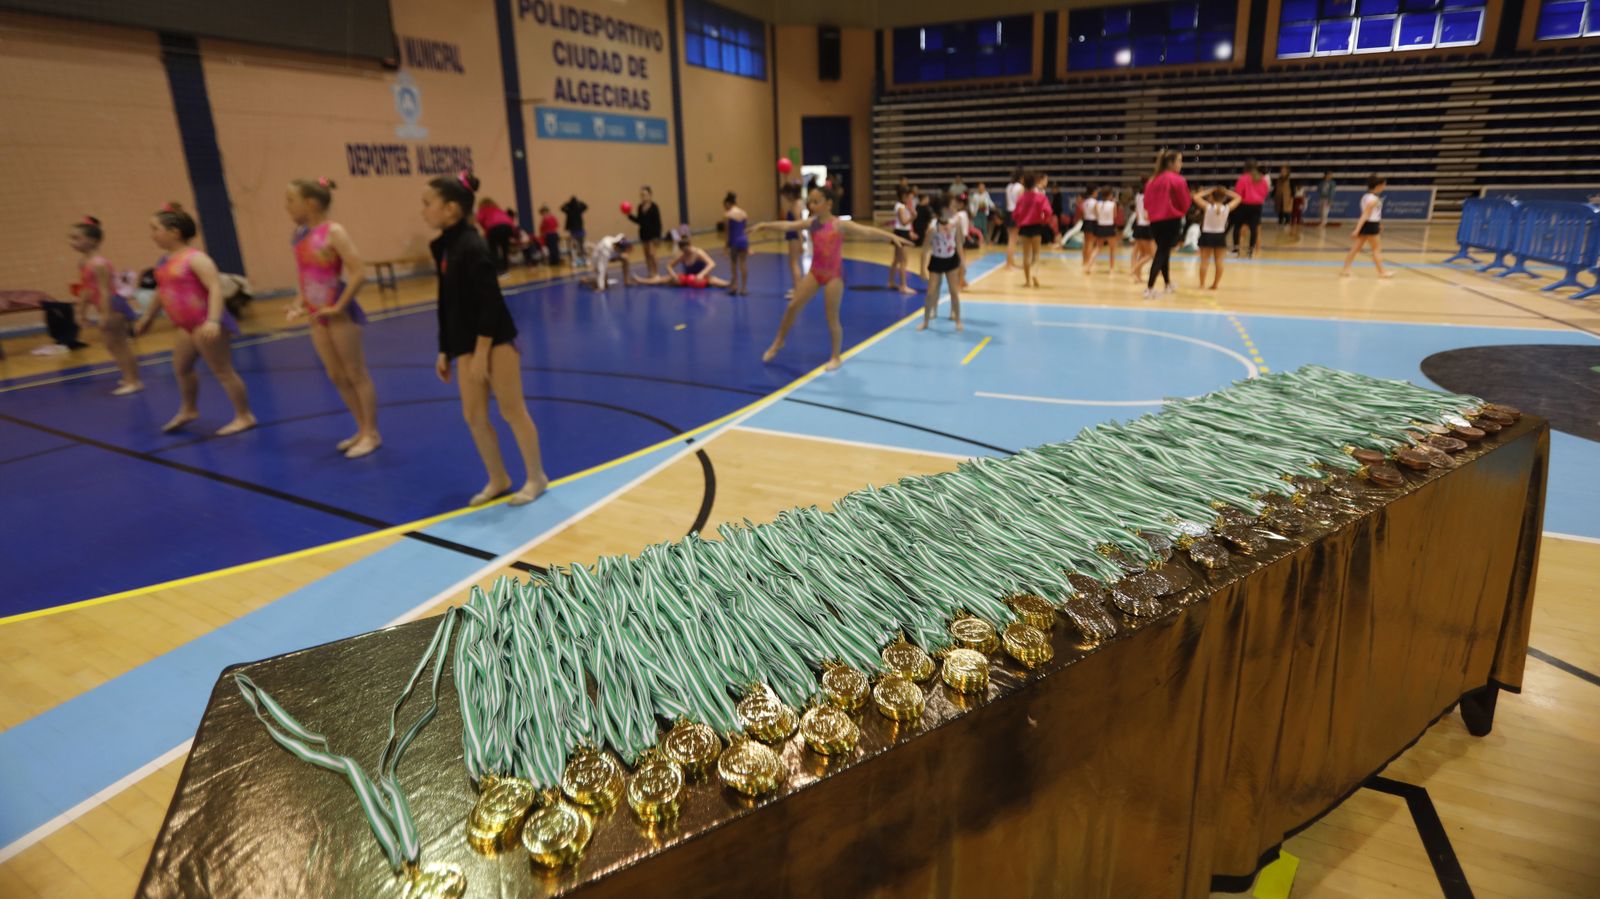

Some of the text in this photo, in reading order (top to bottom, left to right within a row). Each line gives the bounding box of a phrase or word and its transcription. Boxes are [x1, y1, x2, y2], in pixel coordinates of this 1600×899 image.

[518, 0, 664, 52] POLIDEPORTIVO
[552, 39, 649, 79] CIUDAD DE
[554, 76, 651, 111] ALGECIRAS
[345, 143, 412, 176] DEPORTES
